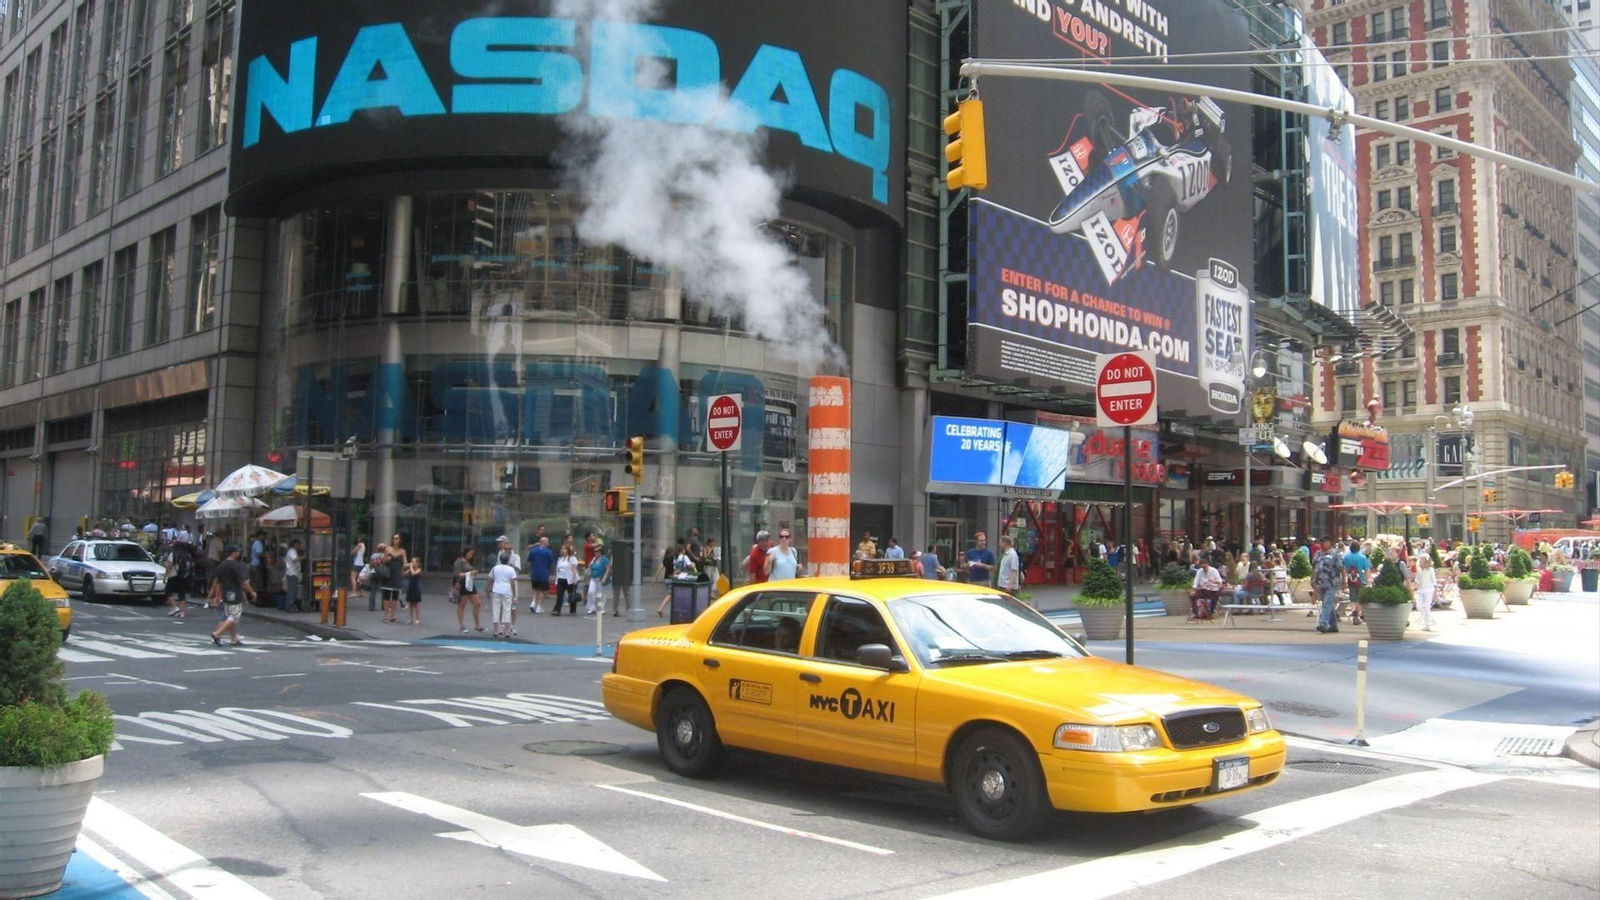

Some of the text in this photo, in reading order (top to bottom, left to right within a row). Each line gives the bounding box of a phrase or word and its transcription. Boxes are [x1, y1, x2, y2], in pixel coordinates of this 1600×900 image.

[1125, 0, 1168, 36] WITH
[1057, 7, 1108, 55] YOU?
[1081, 1, 1168, 63] ANDRETTI
[242, 15, 891, 204] NASDAQ
[1213, 264, 1234, 284] IZOD
[1002, 268, 1042, 292] ENTER
[1045, 281, 1068, 300] FOR
[1071, 290, 1079, 304] A
[1082, 293, 1126, 317] CHANCE
[1129, 307, 1140, 322] TO
[1143, 311, 1163, 329] WIN
[1205, 293, 1242, 335] FASTEST
[1002, 288, 1190, 362] SHOPHONDA.COM
[1205, 357, 1213, 369] IN
[1107, 366, 1144, 380] DO NOT
[1211, 389, 1237, 404] HONDA
[713, 405, 735, 415] DO NOT
[1110, 398, 1143, 412] ENTER
[946, 424, 1002, 439] CELEBRATING
[1252, 422, 1274, 430] KING
[714, 430, 733, 440] ENTER
[961, 438, 1001, 452] 20 YEARS
[1340, 438, 1364, 456] ESPN
[1208, 472, 1236, 480] ESPN
[878, 562, 894, 574] 3F39
[810, 690, 895, 723] NYC TAXI
